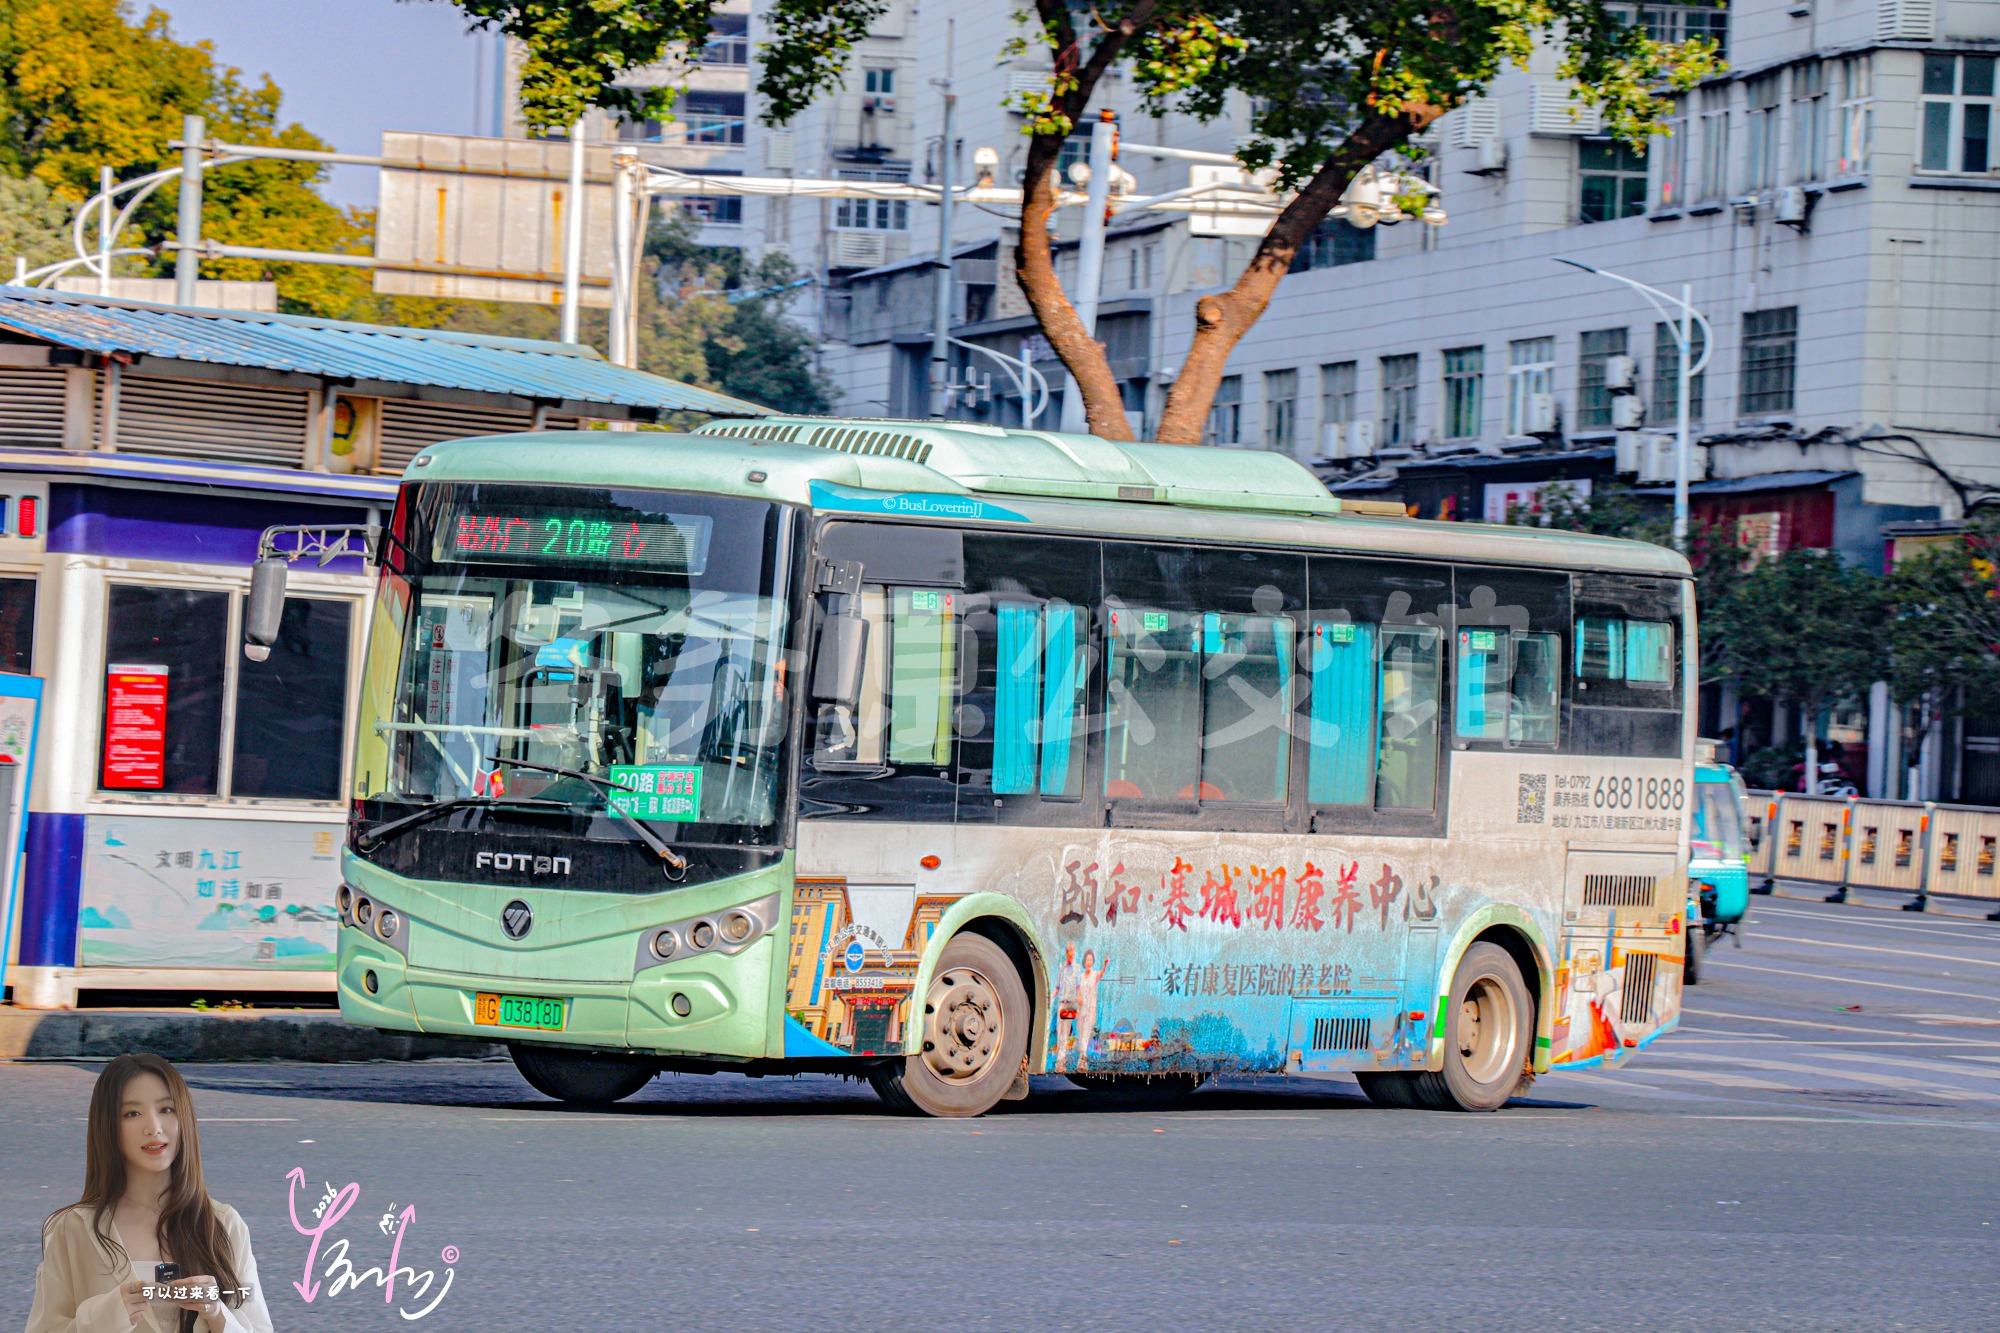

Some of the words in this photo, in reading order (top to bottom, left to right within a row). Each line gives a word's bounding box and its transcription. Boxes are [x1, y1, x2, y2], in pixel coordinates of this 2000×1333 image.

[541, 518, 613, 557] 20路
[616, 772, 654, 793] 20路
[1554, 774, 1591, 789] Tel-0792
[1553, 792, 1590, 808] 康养热线
[1593, 776, 1686, 811] 6881888
[154, 849, 243, 870] 文明九江
[476, 852, 571, 875] FOTON
[195, 878, 283, 900] 如诗如画
[855, 977, 884, 988] 8553416
